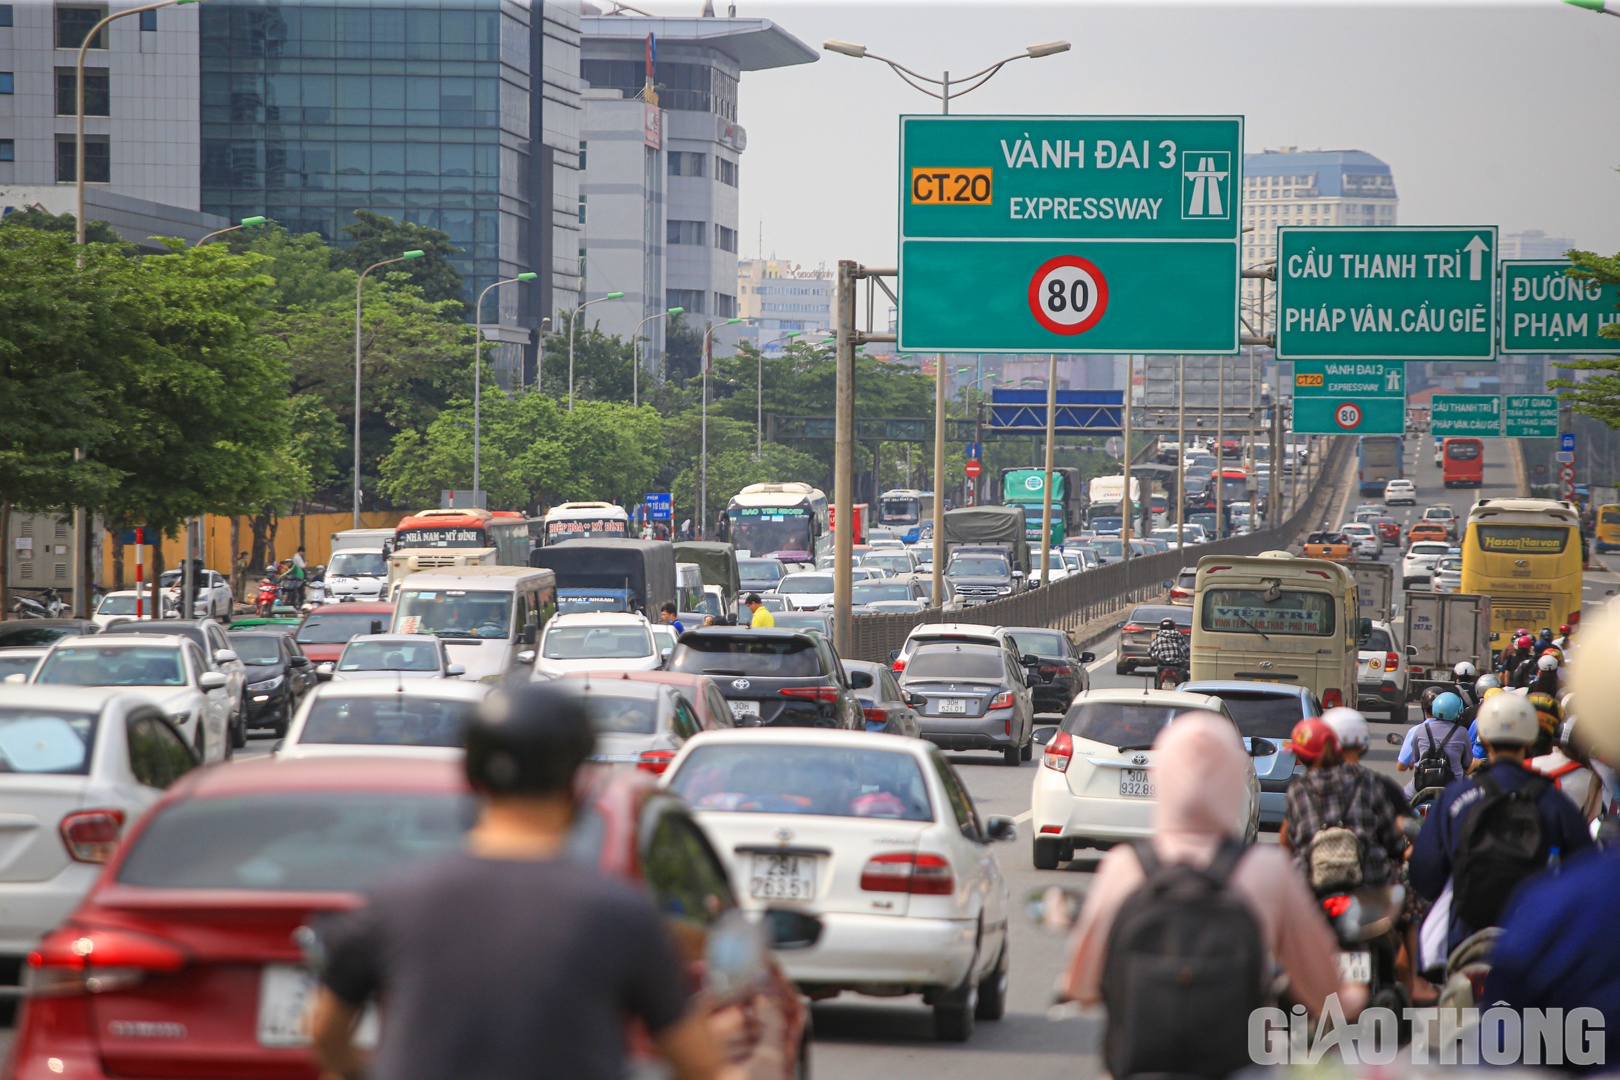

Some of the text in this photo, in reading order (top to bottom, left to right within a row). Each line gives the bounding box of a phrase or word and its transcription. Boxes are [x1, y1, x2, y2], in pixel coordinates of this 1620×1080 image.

[1000, 133, 1177, 169] VÀNH ĐAI 3
[913, 173, 991, 202] CT.20
[1010, 198, 1162, 220] EXPRESSWAY
[1288, 247, 1461, 278] CẦU THANH TRÌ
[1512, 271, 1602, 301] ĐƯỜNG
[1048, 279, 1089, 312] 80
[1285, 303, 1346, 332] PHÁP
[1449, 303, 1486, 332] GIẼ
[1514, 313, 1588, 341] PHẠM
[1325, 363, 1384, 375] VÀNH ĐAI 3
[1328, 383, 1379, 391] EXPRESSWAY
[1450, 403, 1477, 412] THANH
[1341, 410, 1356, 421] 80
[605, 519, 625, 532] ĐÌNH
[423, 532, 440, 541] NAM
[445, 530, 457, 541] MỸ
[458, 529, 477, 541] ĐÌNH
[1217, 607, 1314, 619] VIỆT TRÌ
[734, 702, 750, 710] 30H
[1129, 772, 1148, 782] 30A
[1121, 783, 1155, 794] 932.89
